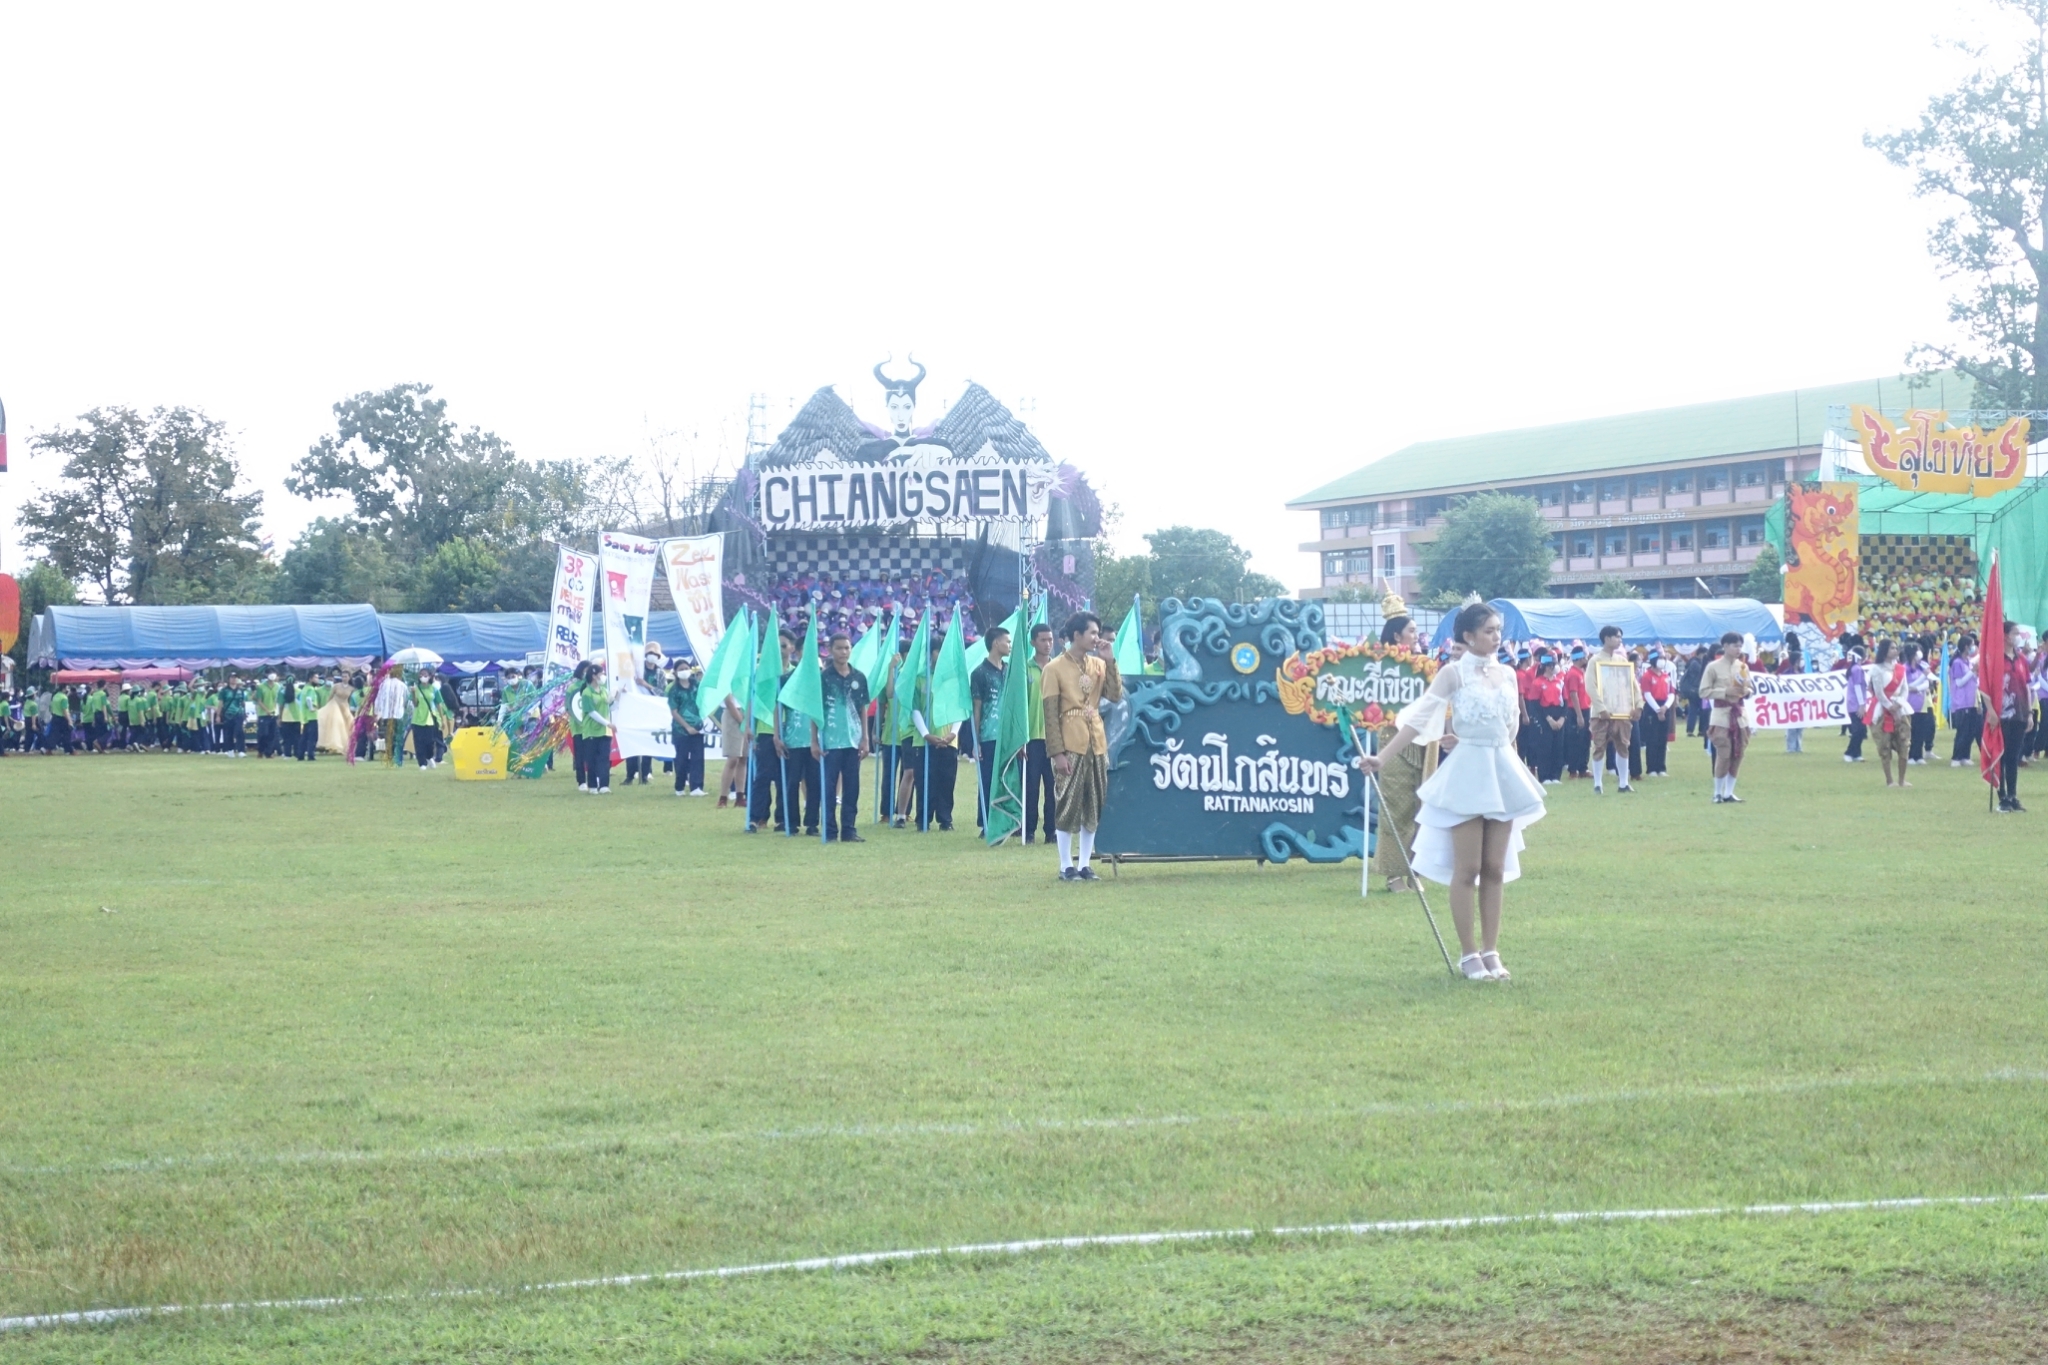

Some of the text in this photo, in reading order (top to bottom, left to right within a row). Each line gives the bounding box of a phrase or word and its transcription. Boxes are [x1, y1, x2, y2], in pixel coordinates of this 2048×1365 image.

[1899, 409, 1994, 488] สุโขทัย
[765, 469, 1028, 524] CHIANGSAEN
[603, 533, 631, 553] Save
[564, 554, 584, 578] 3R
[1203, 795, 1314, 814] RATTANAKOSIN
